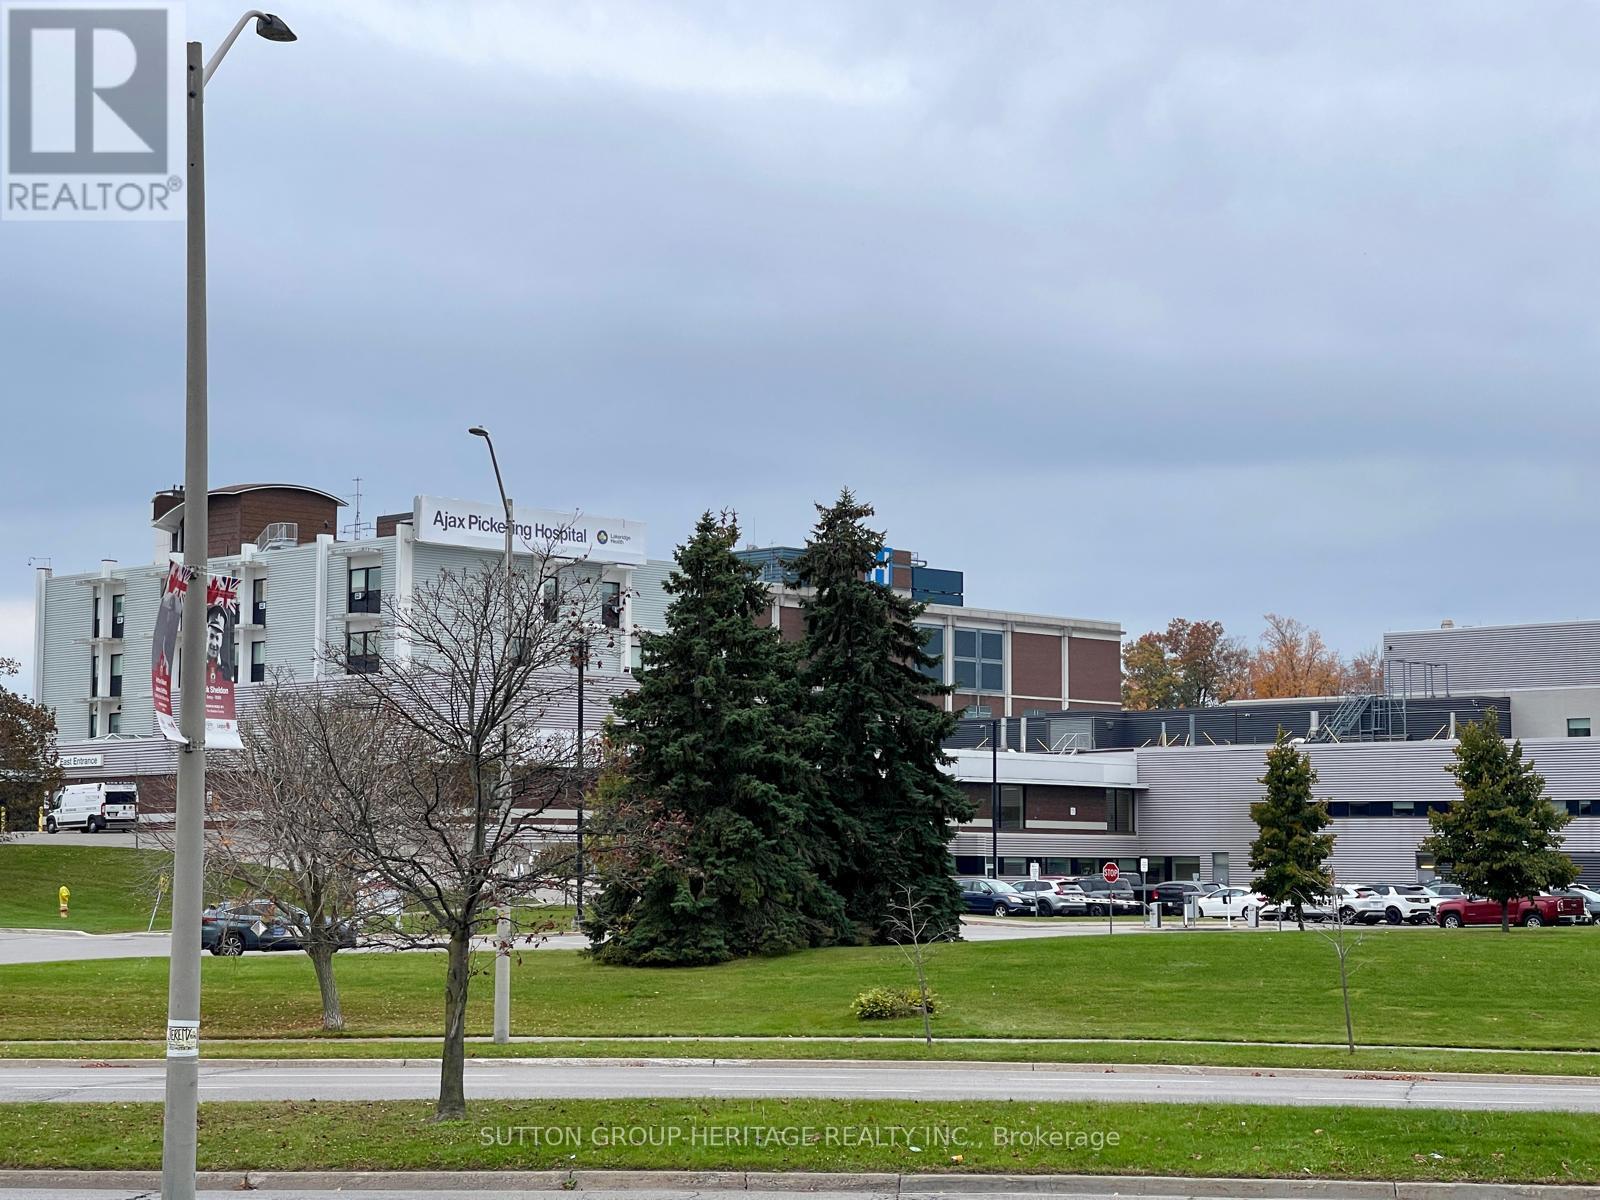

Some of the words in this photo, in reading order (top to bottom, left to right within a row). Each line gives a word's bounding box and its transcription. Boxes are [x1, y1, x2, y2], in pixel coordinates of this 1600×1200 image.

[433, 510, 466, 531] Ajax
[468, 514, 532, 540] Pickeing
[535, 523, 587, 543] Hospital
[210, 686, 229, 694] Sheldon
[60, 757, 73, 766] East
[73, 757, 98, 765] Entrance
[1104, 868, 1118, 877] STOP
